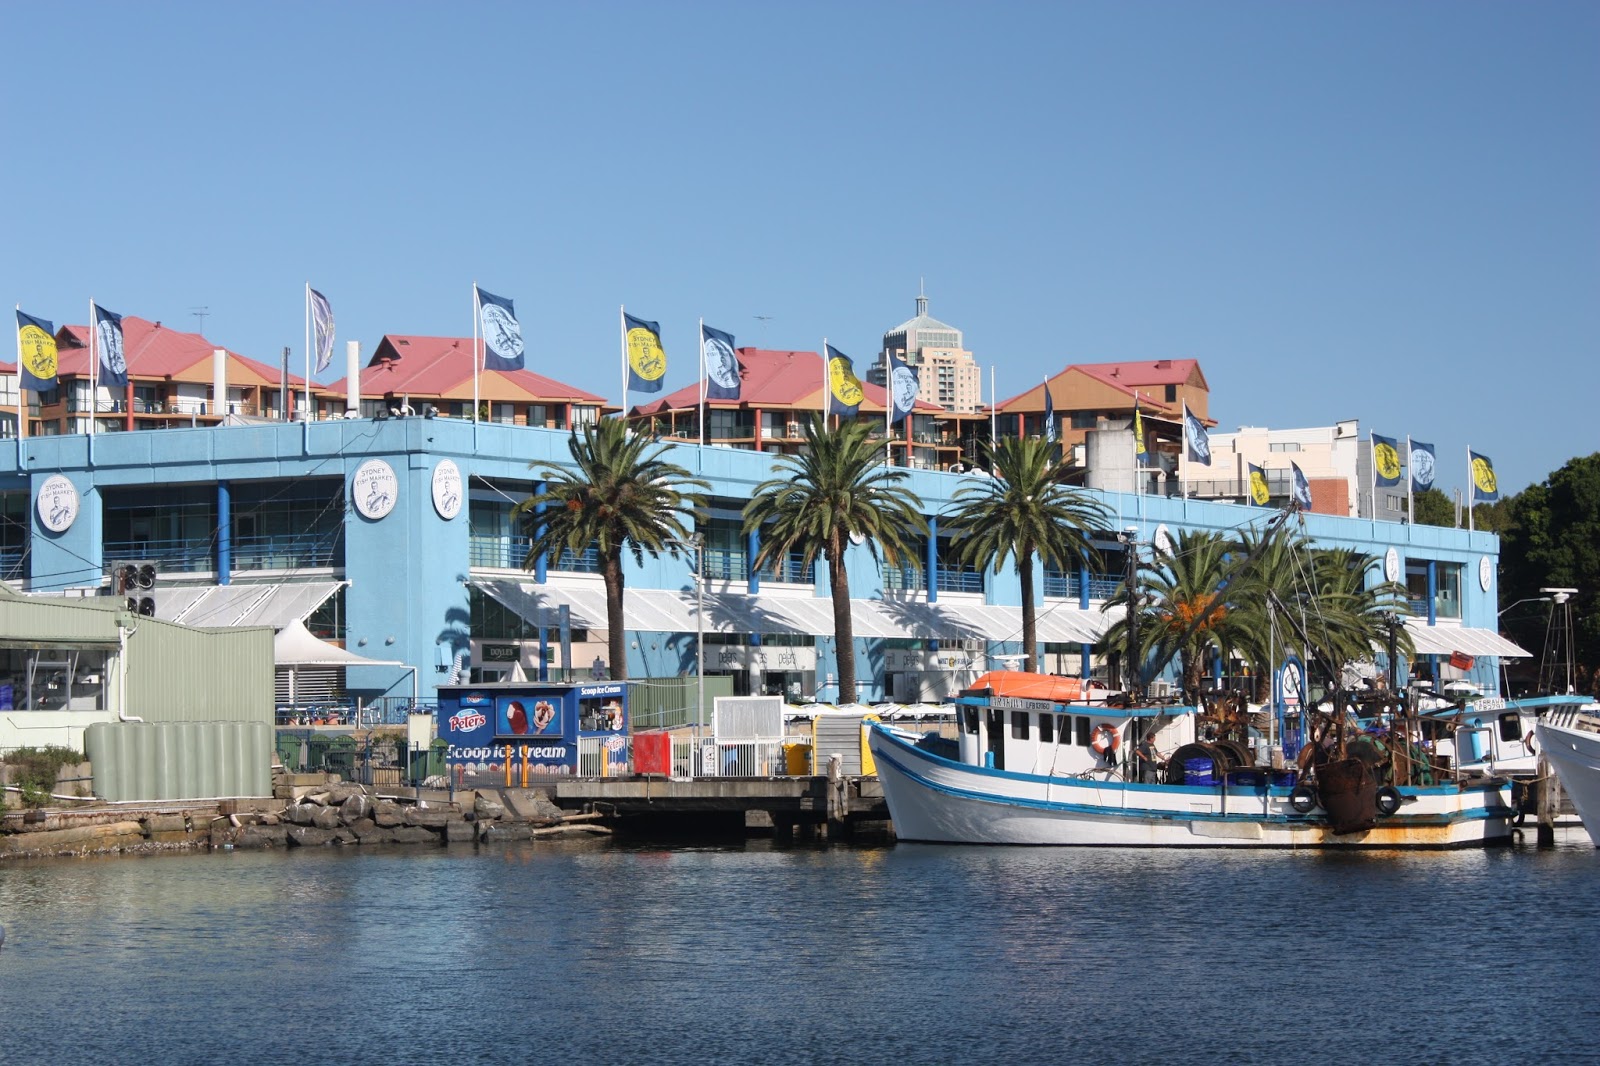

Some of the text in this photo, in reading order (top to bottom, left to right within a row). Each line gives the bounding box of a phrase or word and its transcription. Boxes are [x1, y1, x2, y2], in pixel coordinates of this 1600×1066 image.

[361, 468, 385, 477] SYDNEY
[438, 468, 455, 476] SYDNEY
[356, 475, 392, 487] FISH MARKET
[45, 483, 67, 491] SYDNEY
[41, 490, 73, 501] FISH MARKET
[490, 649, 513, 657] DOYLES
[581, 687, 596, 696] Scoop
[604, 685, 621, 693] Cream
[450, 715, 486, 731] Peters
[446, 745, 492, 762] Scoop
